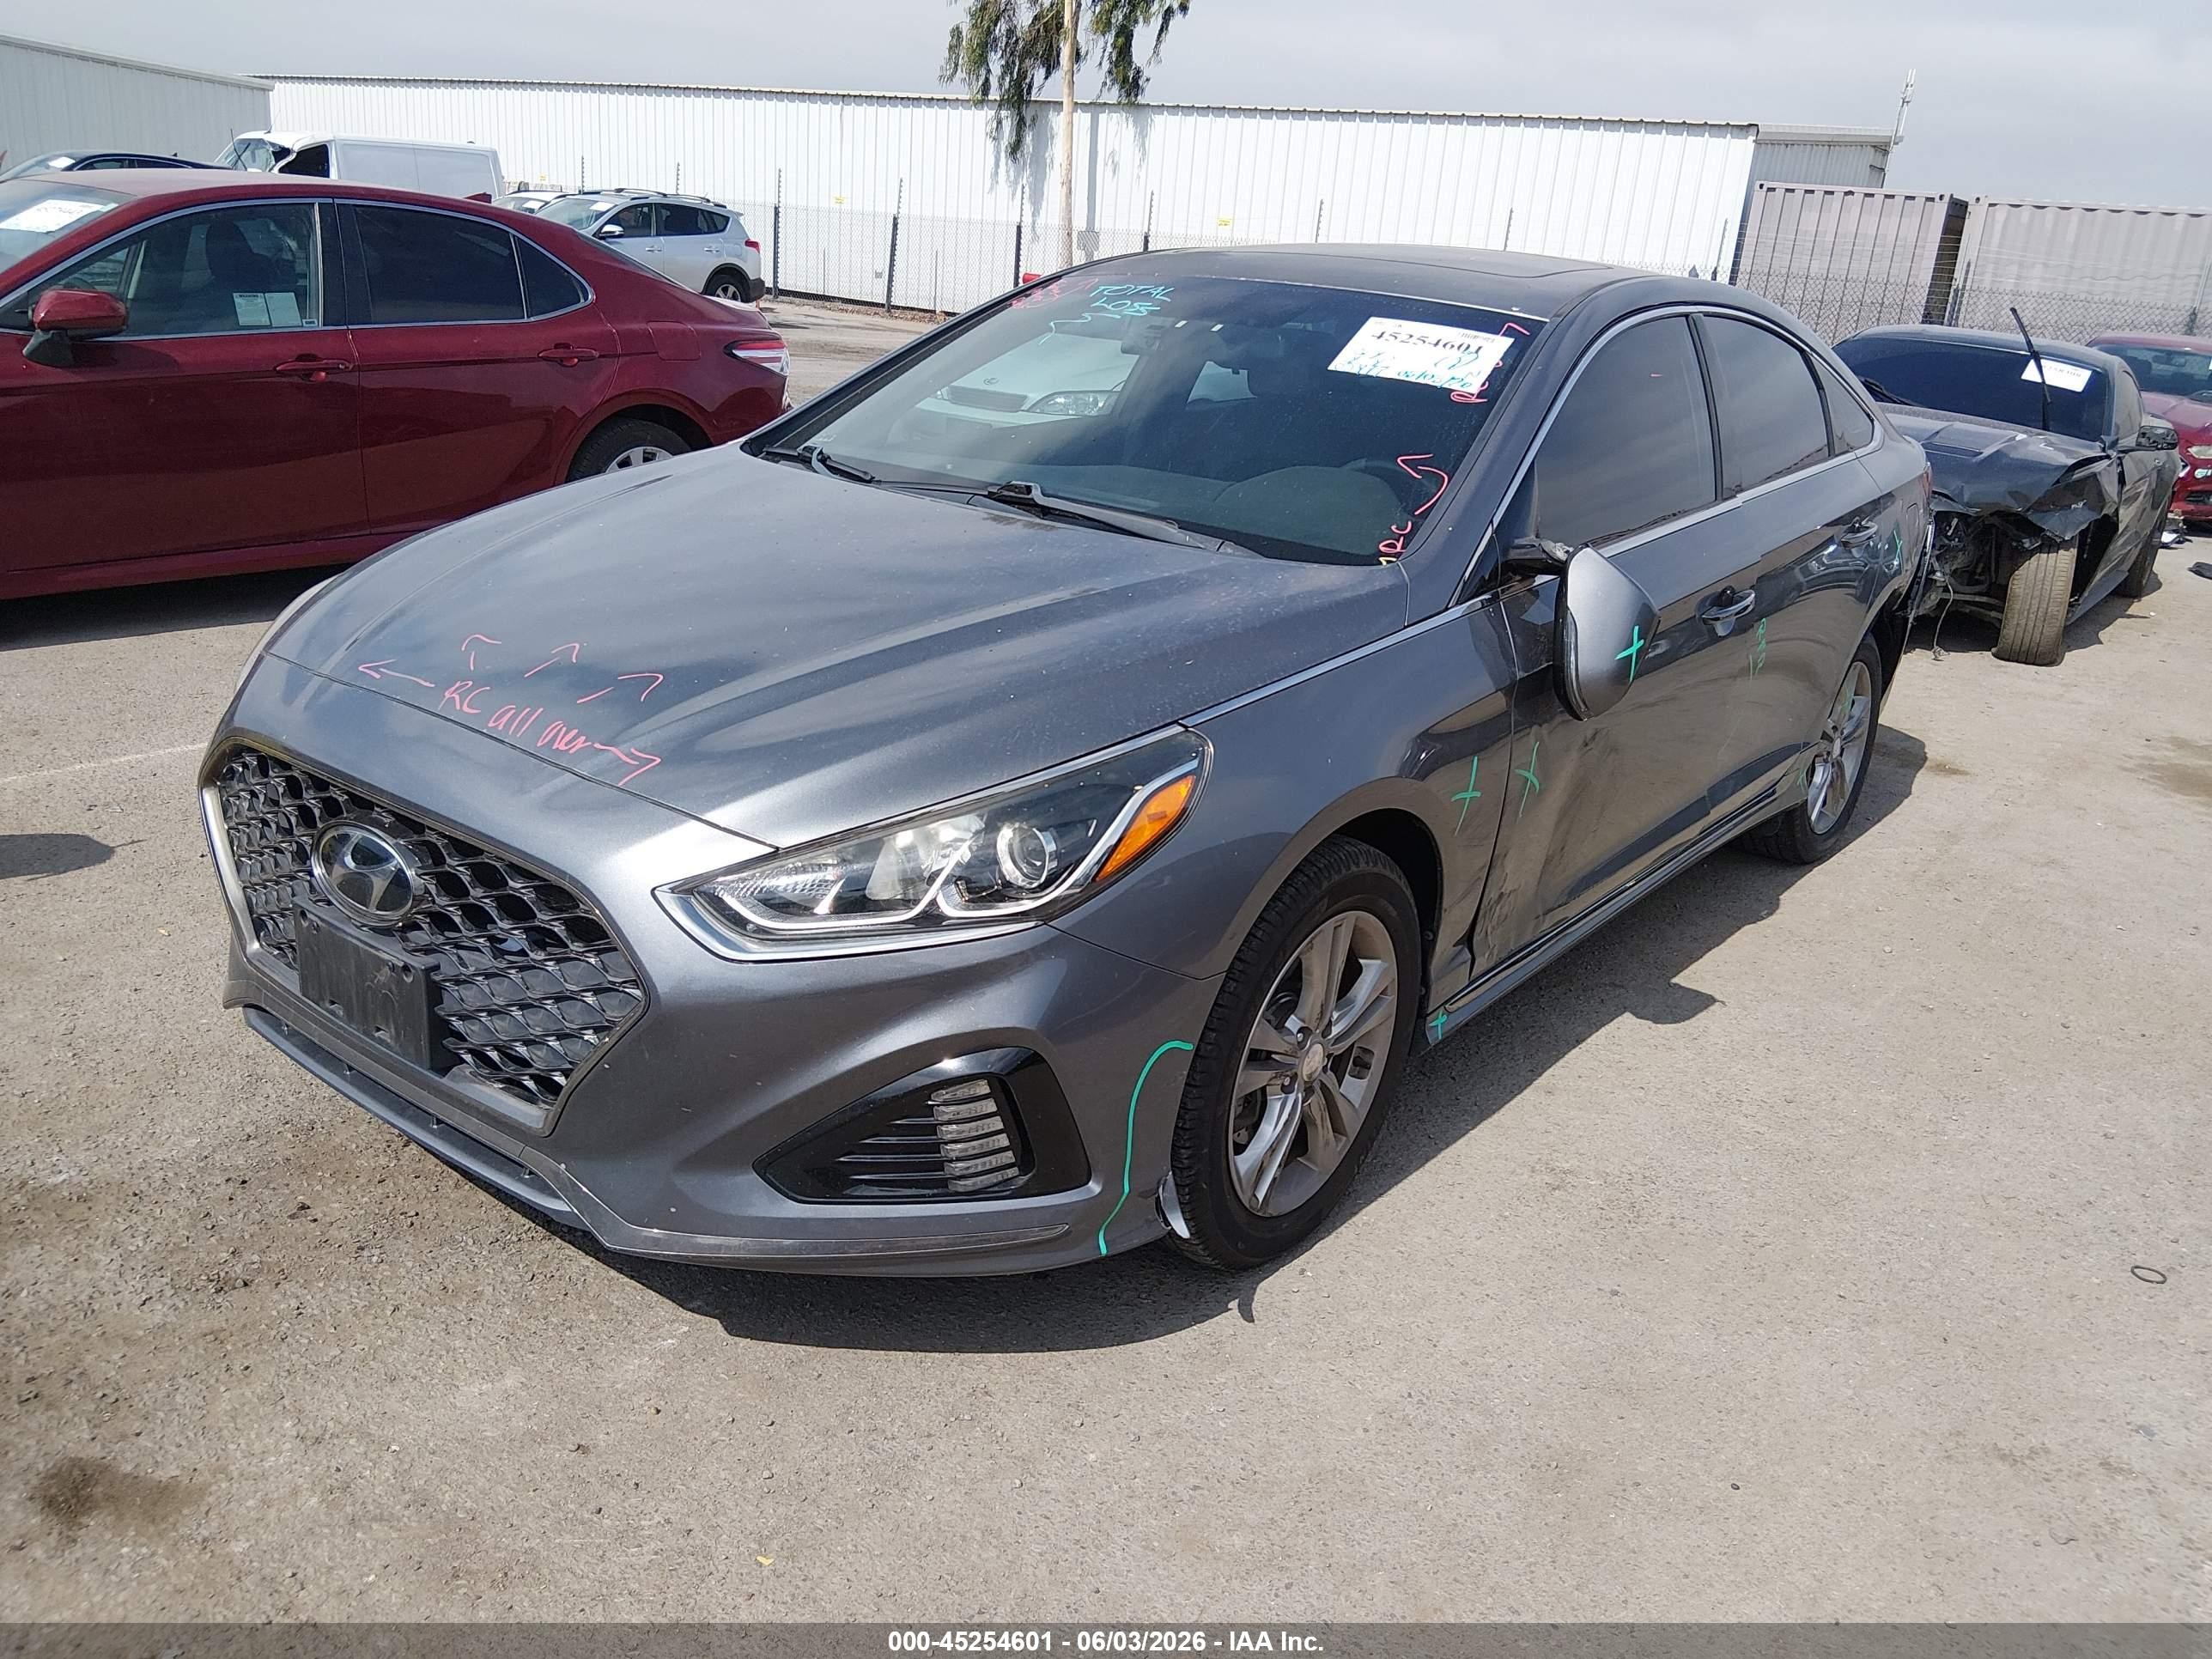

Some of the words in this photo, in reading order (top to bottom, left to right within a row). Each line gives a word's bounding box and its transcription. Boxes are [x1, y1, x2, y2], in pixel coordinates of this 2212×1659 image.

[1090, 285, 1174, 301] TOTAL
[1091, 297, 1160, 315] LOSS
[1371, 331, 1483, 355] 45254601
[439, 680, 489, 714] RC
[487, 704, 544, 737] all
